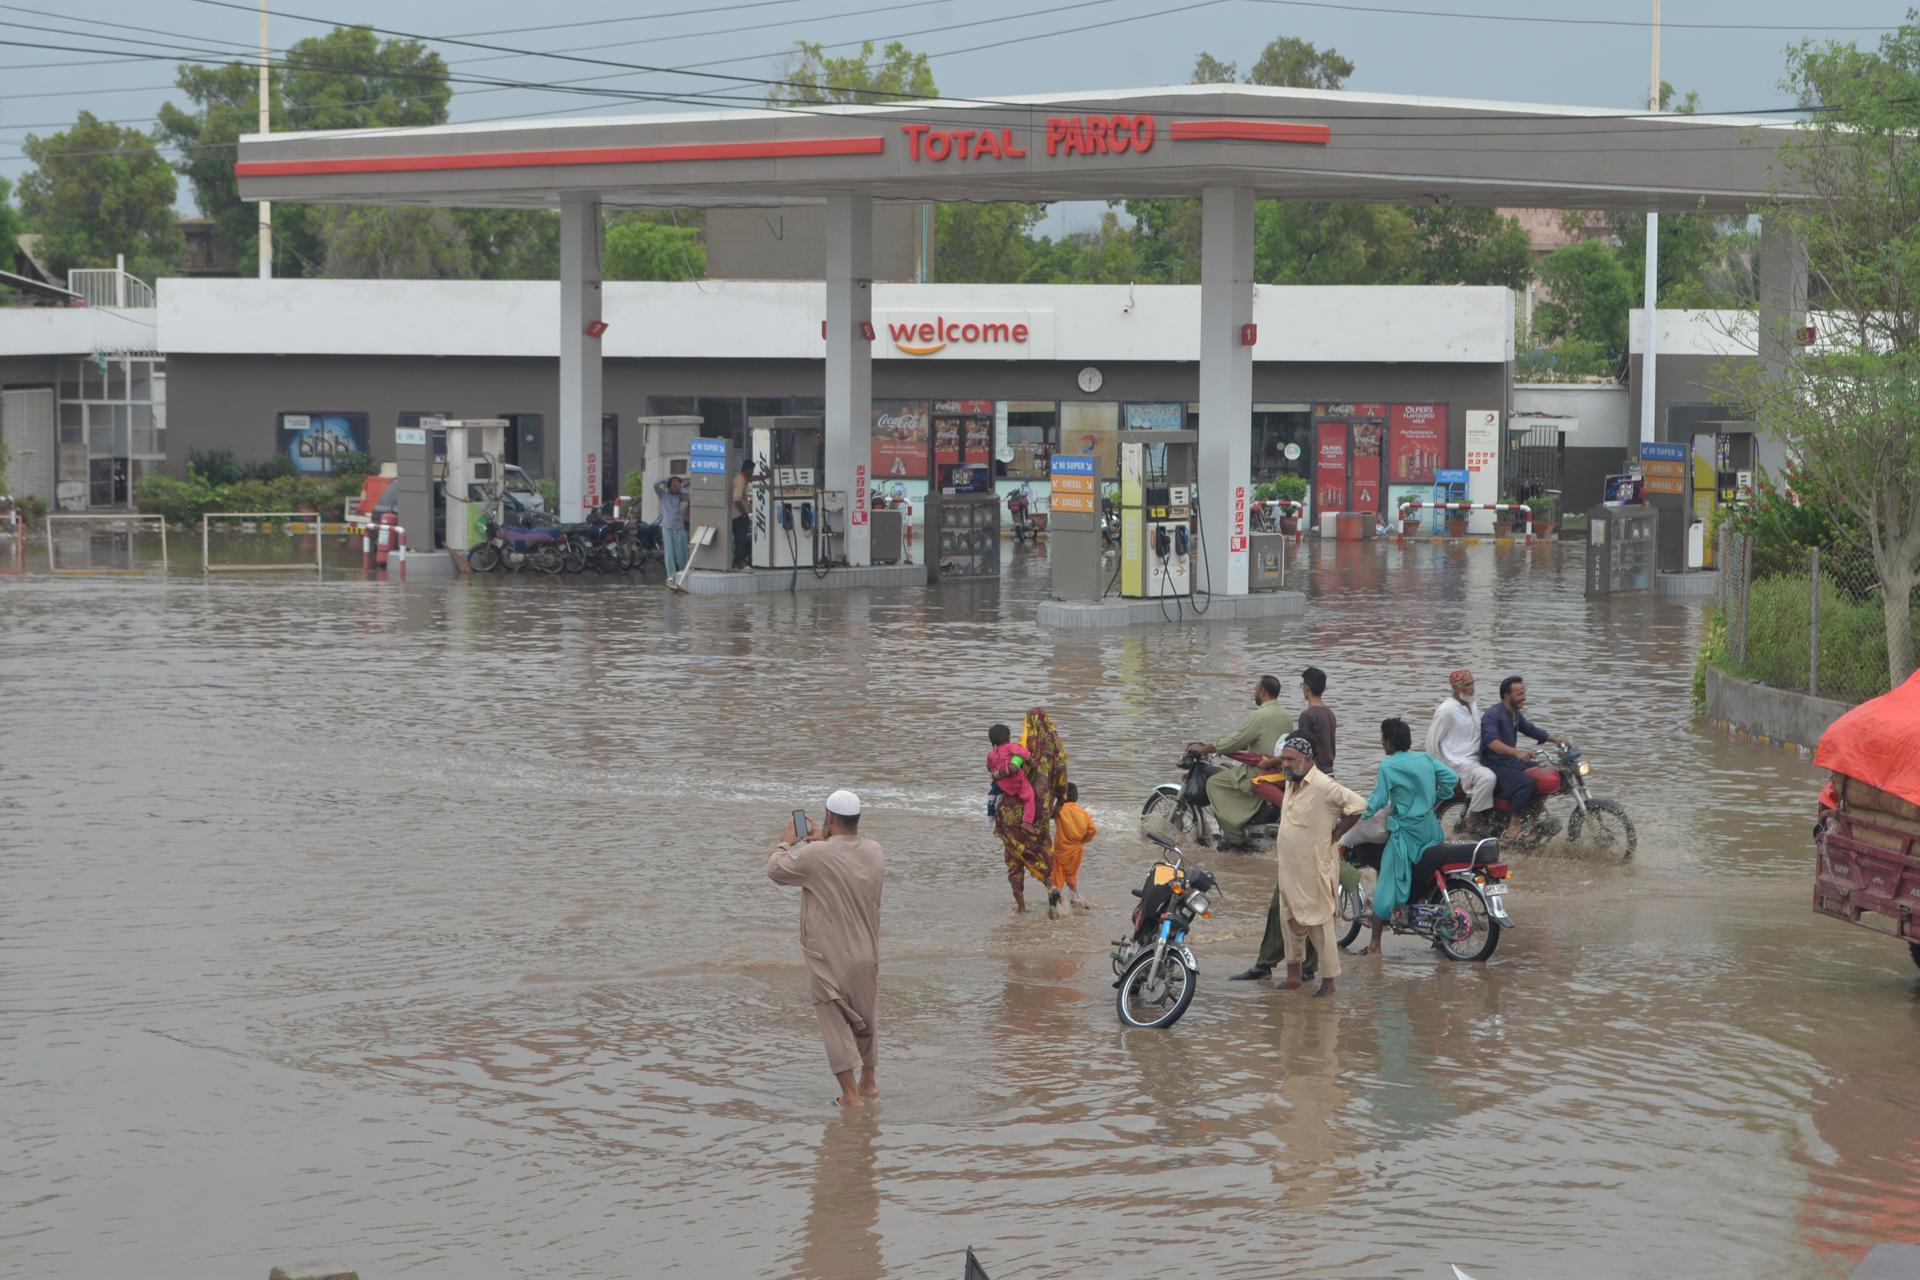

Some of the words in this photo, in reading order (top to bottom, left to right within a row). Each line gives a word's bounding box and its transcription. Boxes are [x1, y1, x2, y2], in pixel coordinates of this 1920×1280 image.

[902, 123, 1026, 161] TOTAL
[1046, 114, 1155, 156] PARCO
[888, 316, 1028, 344] welcome
[703, 444, 719, 452] SUPER
[1656, 448, 1676, 458] SUPER
[703, 461, 719, 469] SUPER
[1066, 461, 1085, 470] SUPER
[1063, 479, 1082, 488] DIESEL
[1063, 498, 1082, 507] DIESEL
